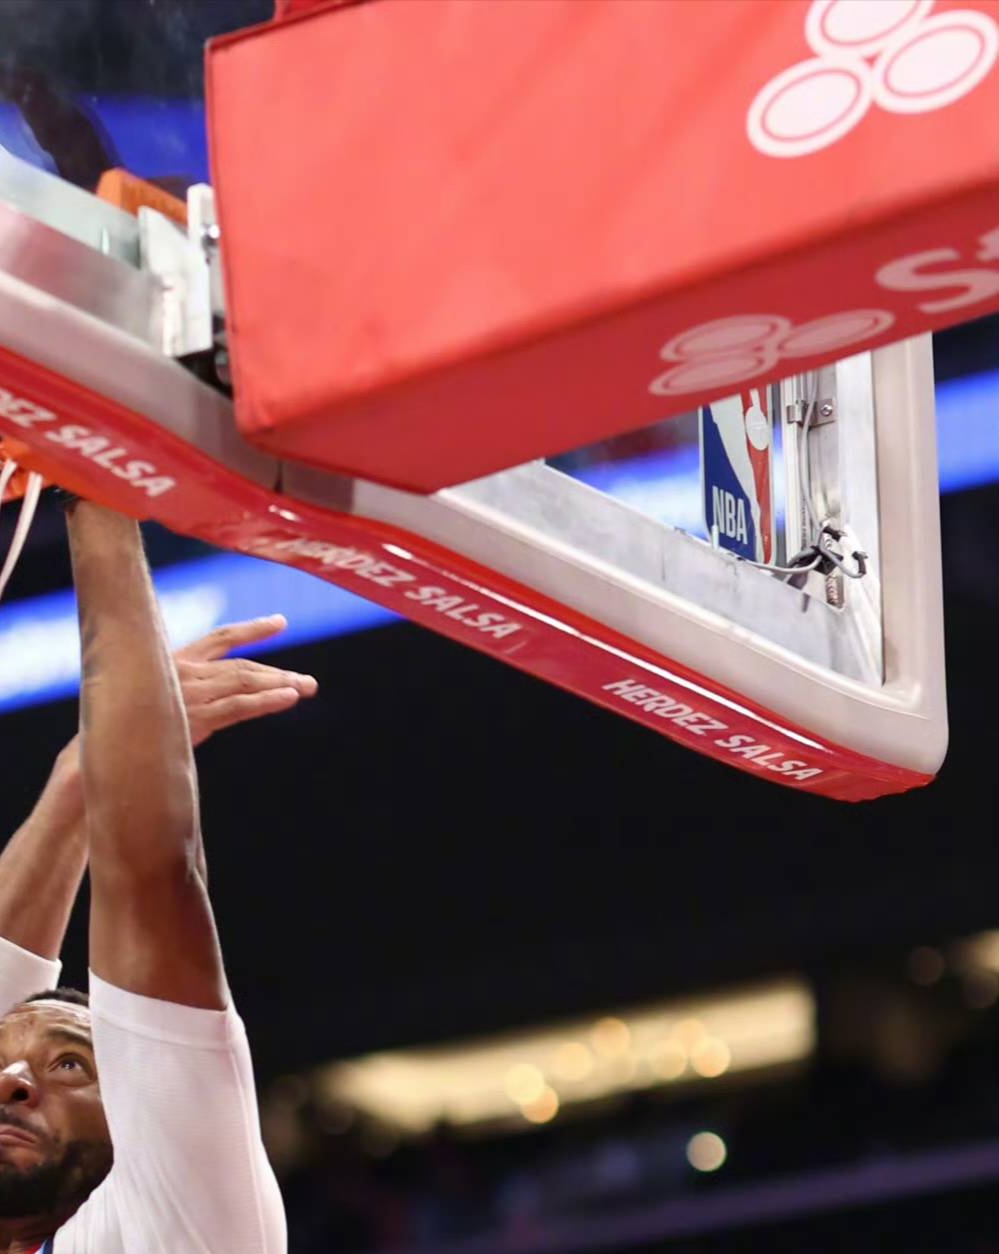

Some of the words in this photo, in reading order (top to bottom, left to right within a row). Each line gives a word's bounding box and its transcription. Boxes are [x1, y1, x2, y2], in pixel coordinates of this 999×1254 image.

[46, 424, 176, 496] SALSA
[711, 484, 749, 545] NBA
[404, 584, 523, 639] SALSA
[602, 679, 729, 736] HERDEZ
[714, 734, 824, 781] SALSA
